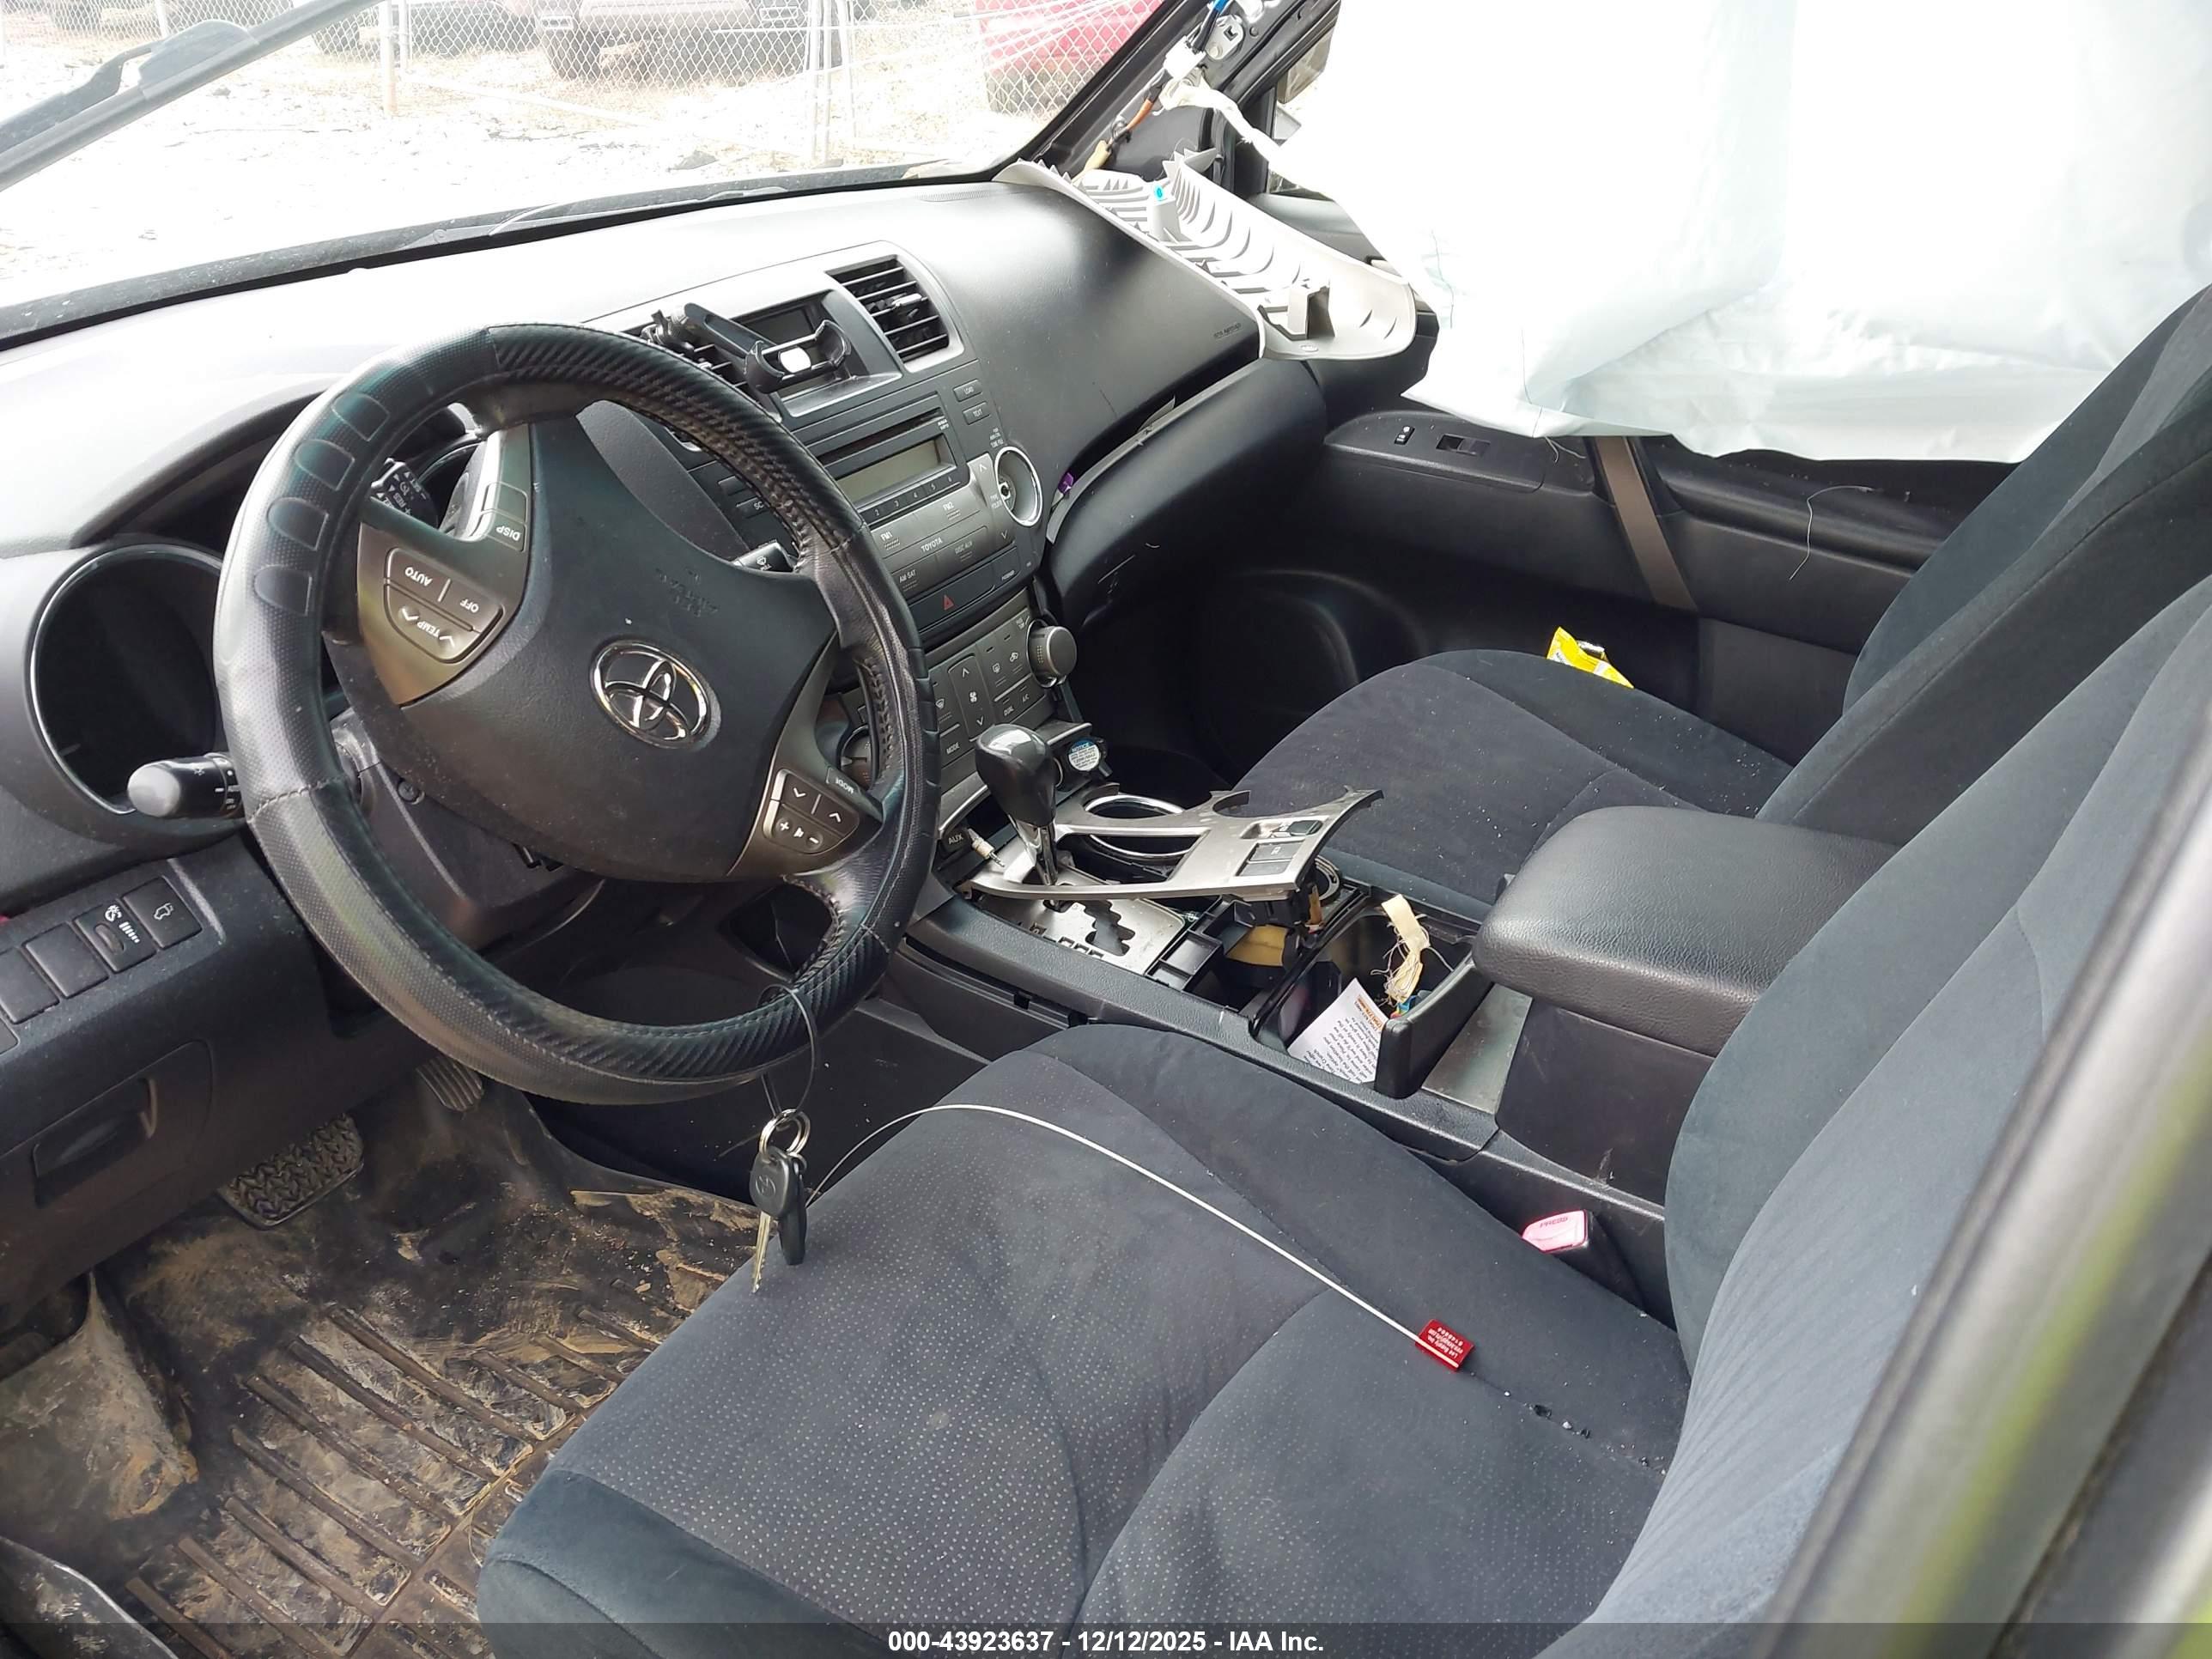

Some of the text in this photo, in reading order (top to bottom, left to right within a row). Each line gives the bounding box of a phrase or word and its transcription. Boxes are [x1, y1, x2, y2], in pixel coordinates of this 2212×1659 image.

[495, 526, 521, 542] DISP
[880, 532, 892, 542] FM1
[921, 537, 943, 553] TOYOTA
[404, 567, 433, 586] AUTO
[460, 599, 479, 613] OFF
[417, 621, 441, 638] TEMP
[946, 741, 960, 757] MODE
[835, 776, 854, 794] MODE
[948, 832, 963, 845] AUX
